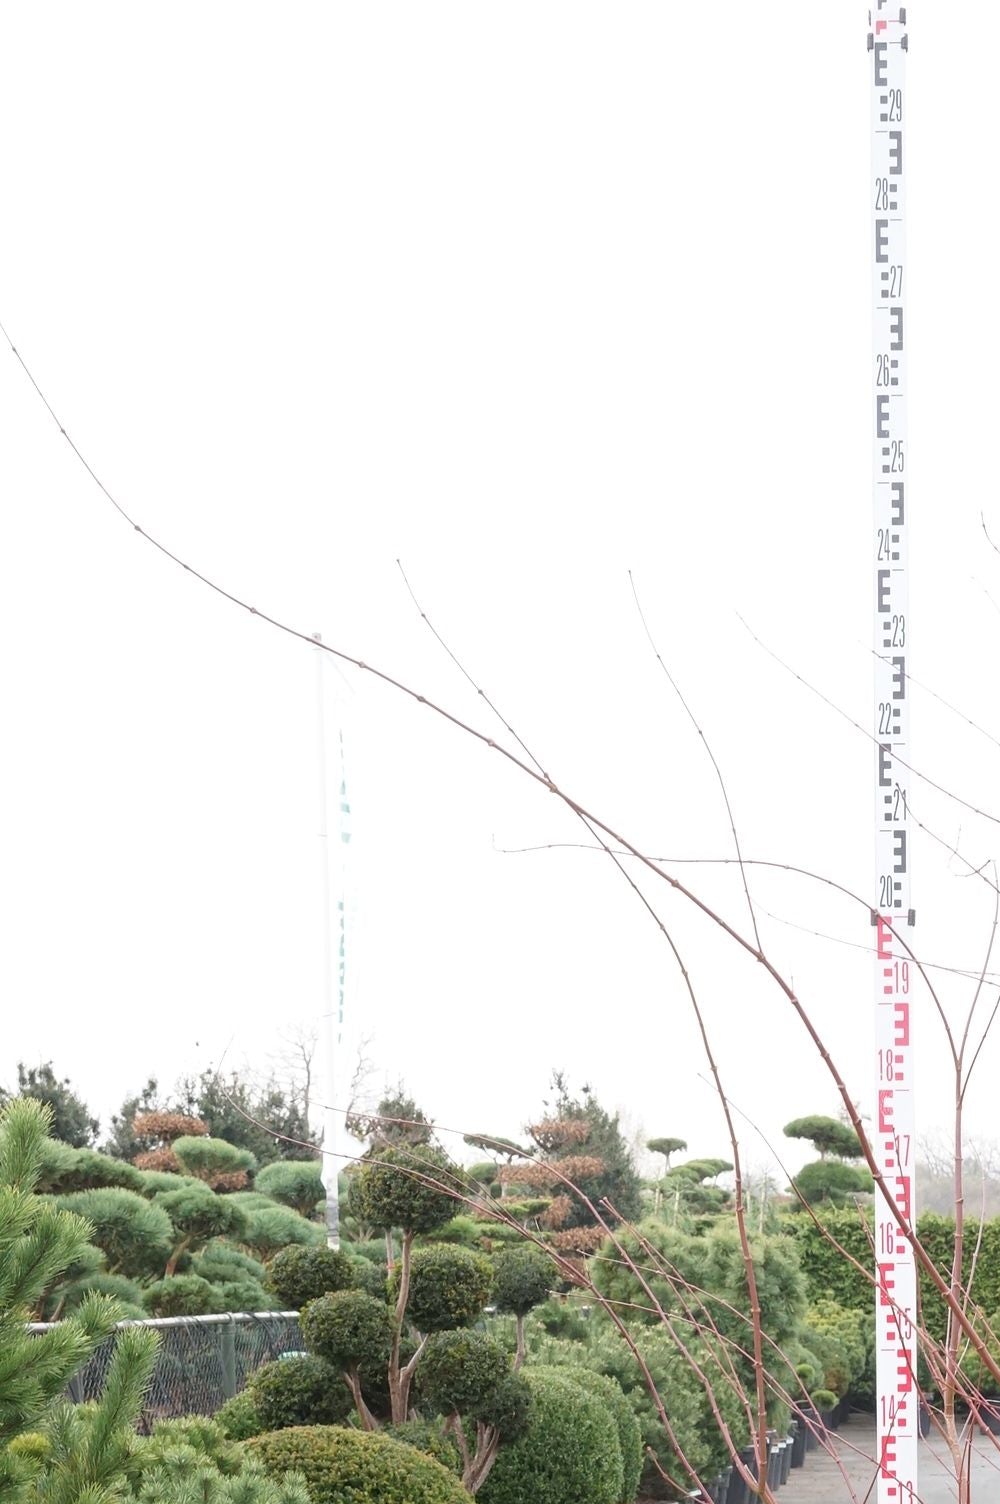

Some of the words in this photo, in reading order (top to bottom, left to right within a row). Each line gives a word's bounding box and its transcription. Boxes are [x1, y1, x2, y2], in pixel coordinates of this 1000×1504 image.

[889, 90, 902, 121] 29
[875, 178, 888, 210] 28
[890, 266, 902, 298] 27
[877, 354, 889, 386] 26
[891, 441, 904, 472] 25
[878, 529, 890, 560] 24
[892, 615, 905, 647] 23
[879, 703, 891, 735] 22
[894, 789, 906, 821] 21
[880, 876, 892, 907] 20
[894, 962, 909, 994] 19
[878, 1049, 893, 1081] 18
[895, 1135, 910, 1167] 17
[880, 1223, 893, 1254] 16
[898, 1308, 912, 1340] 15
[881, 1396, 894, 1427] 14
